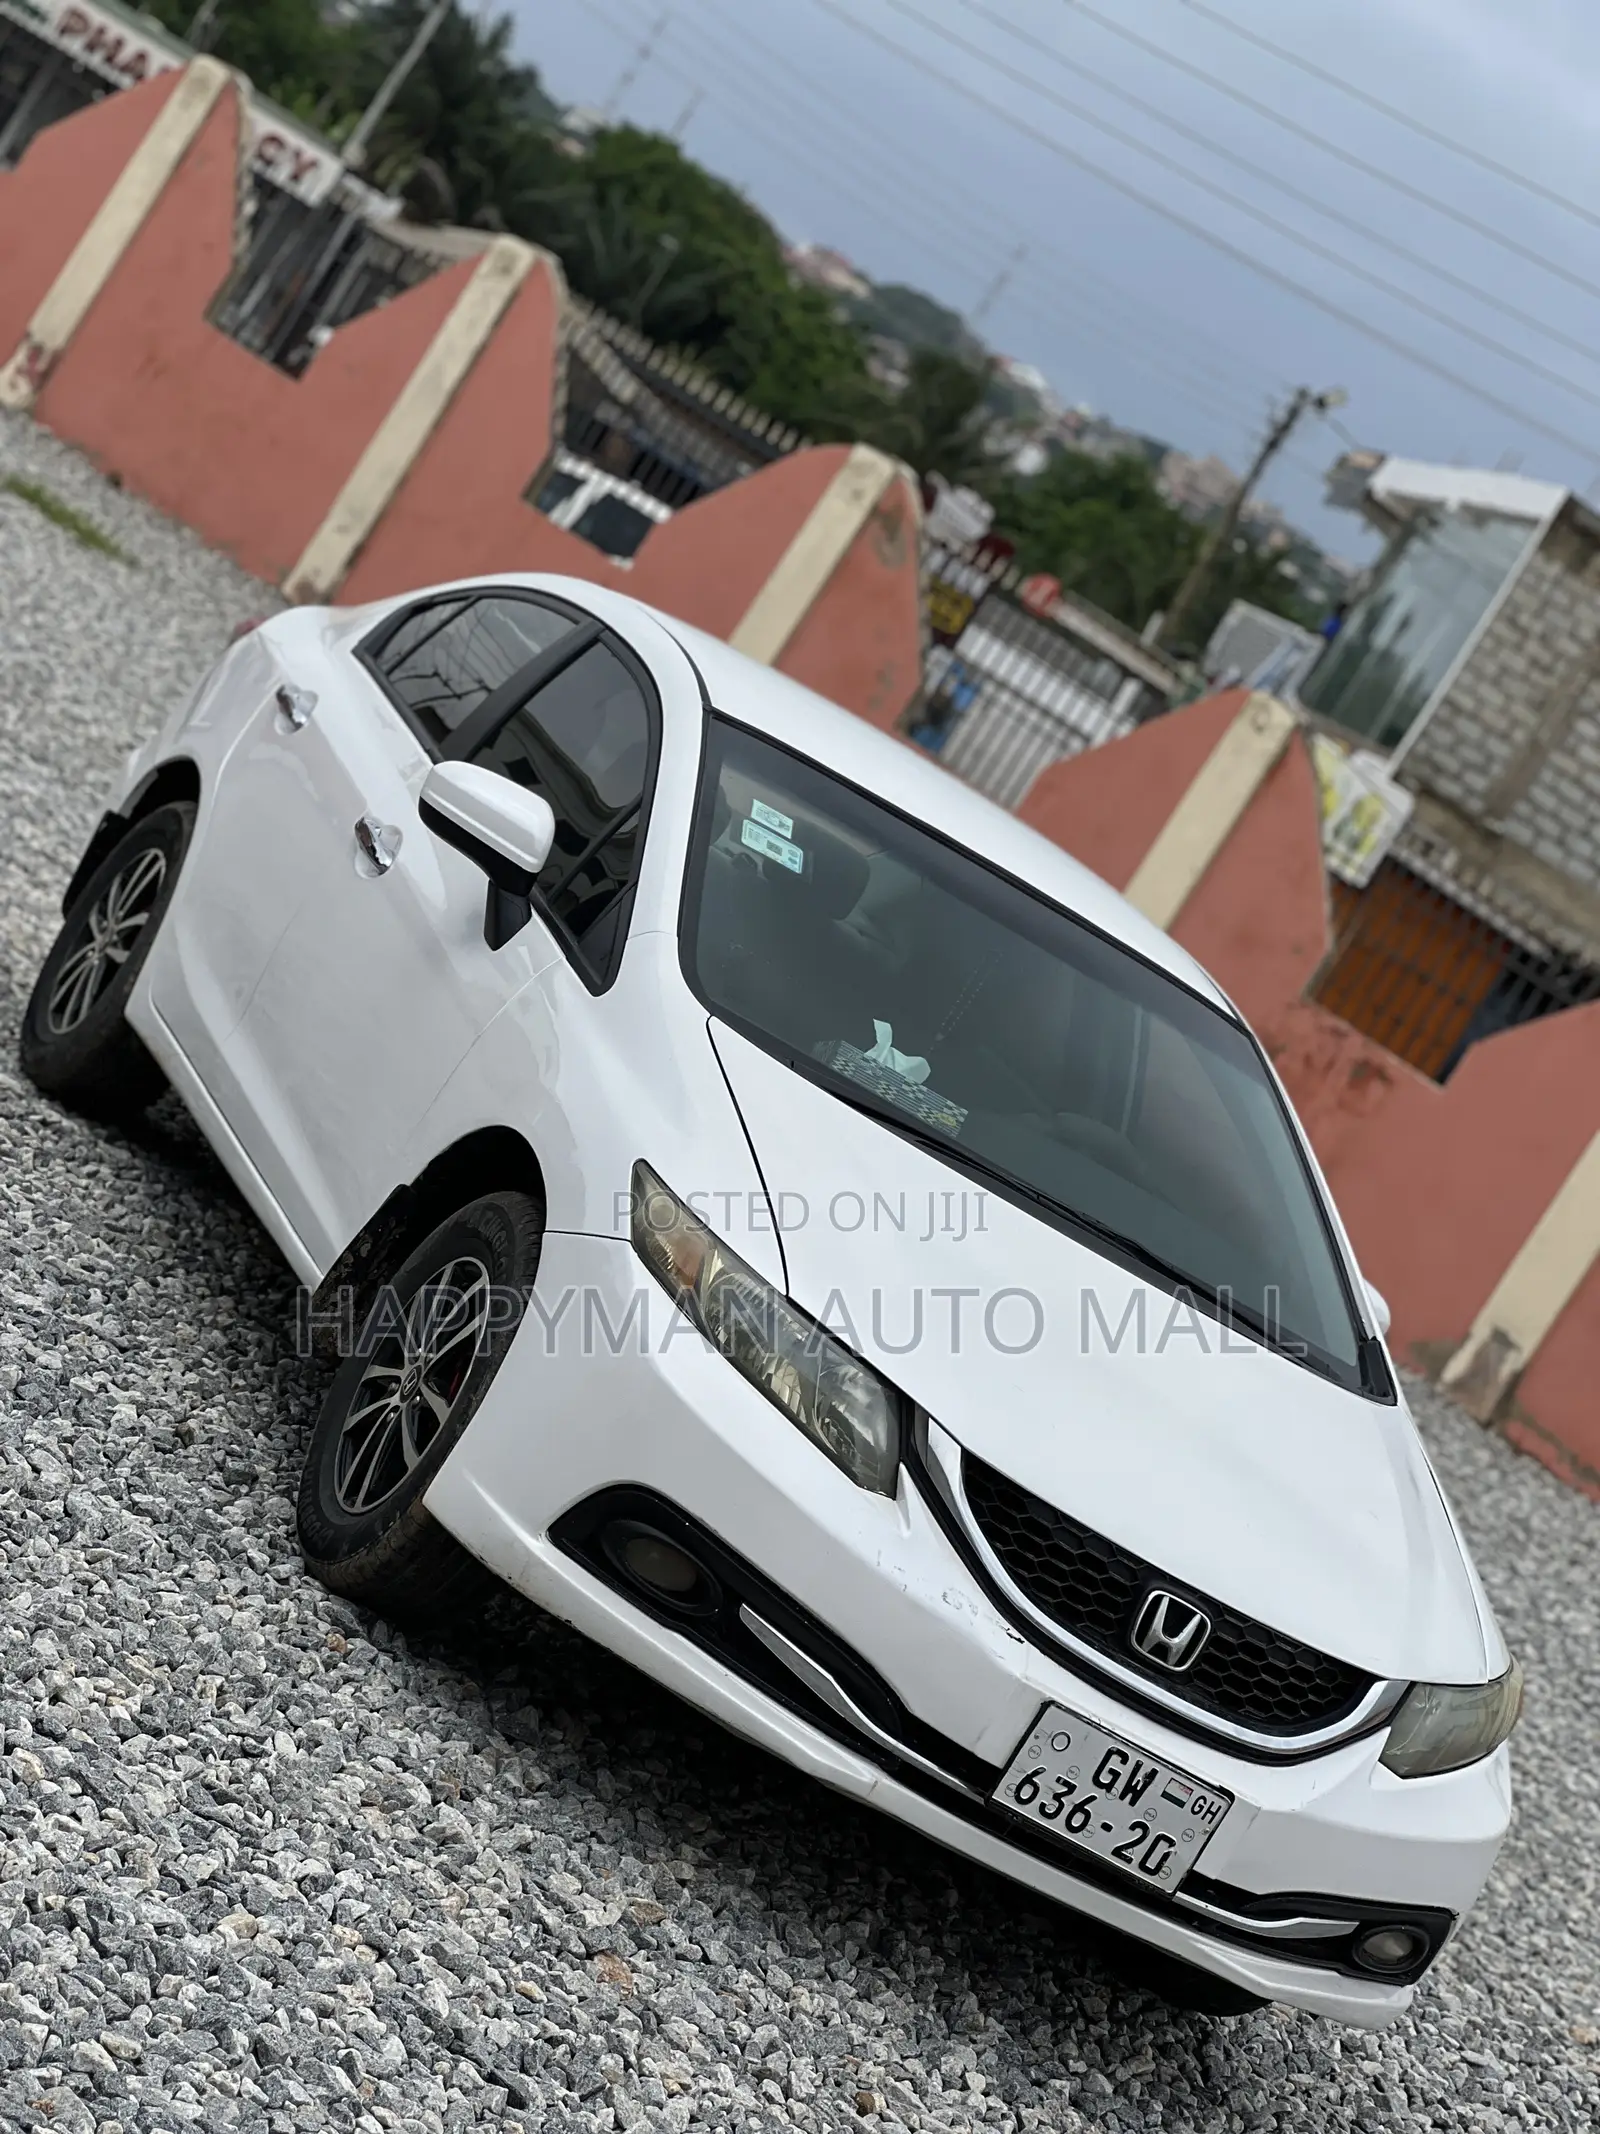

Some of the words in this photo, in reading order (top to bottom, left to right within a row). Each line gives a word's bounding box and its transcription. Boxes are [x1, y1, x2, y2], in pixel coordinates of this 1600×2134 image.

[1014, 1766, 1177, 1877] 636-20
[1091, 1746, 1159, 1807] GW
[1190, 1795, 1222, 1825] GH
